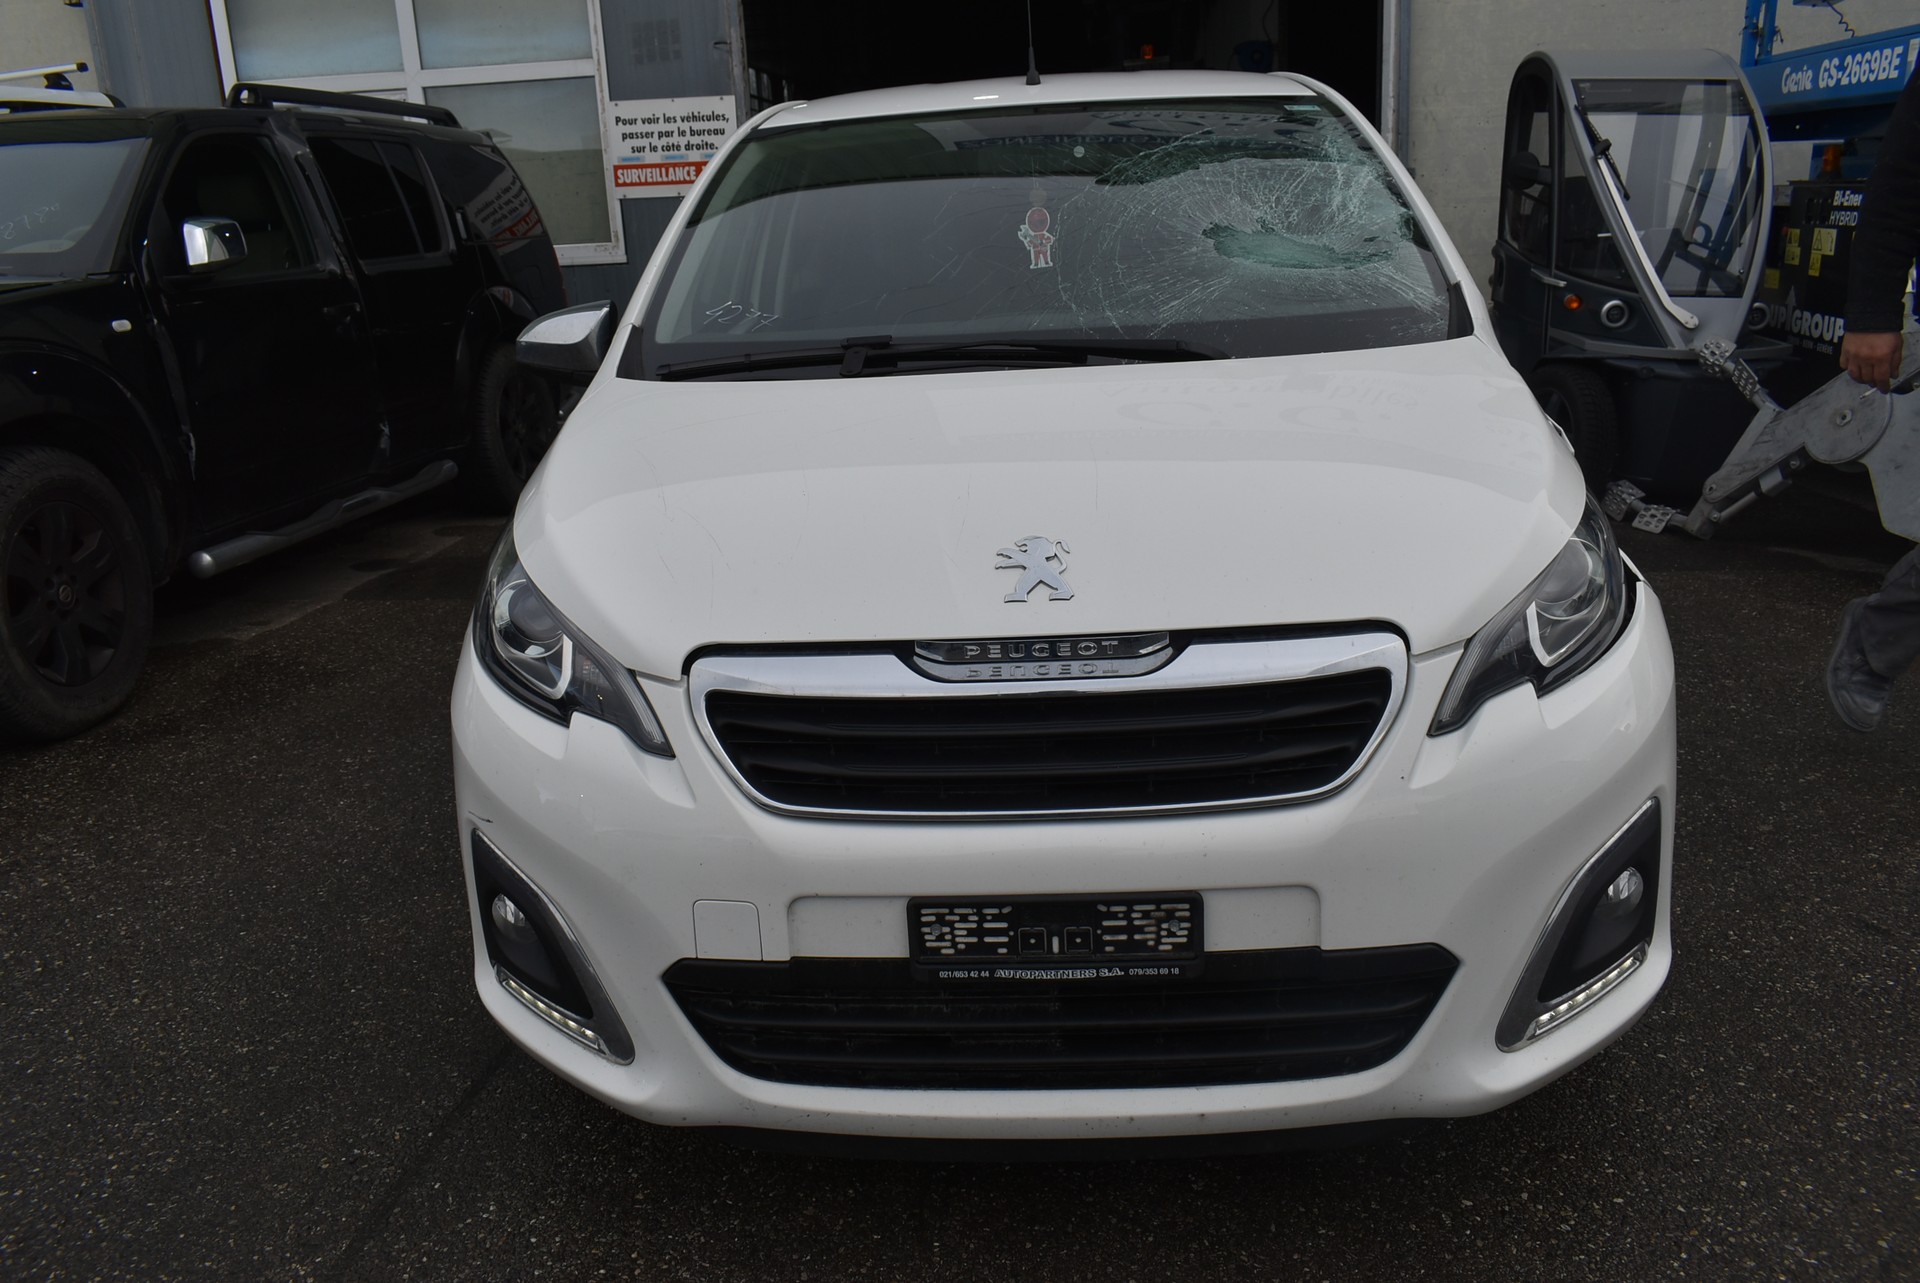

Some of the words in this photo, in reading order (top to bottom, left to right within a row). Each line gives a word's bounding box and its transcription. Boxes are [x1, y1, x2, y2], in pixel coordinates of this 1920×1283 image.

[1781, 64, 1813, 94] Genie
[1818, 45, 1904, 89] GS-2669BE
[615, 116, 638, 126] Pour
[641, 113, 660, 124] voir
[663, 112, 677, 124] les
[680, 110, 729, 123] véhicules,
[622, 130, 654, 142] passer
[658, 129, 674, 141] par
[677, 126, 687, 137] le
[689, 125, 725, 137] bureau
[631, 144, 646, 154] sur
[649, 142, 658, 153] le
[661, 141, 682, 152] côté
[684, 139, 719, 151] droite.
[617, 165, 697, 184] SURVEILLANCE
[1833, 190, 1863, 206] Bi-Ener
[1829, 211, 1859, 227] HYBRID
[1791, 308, 1845, 344] GROUP
[963, 640, 1119, 659] PEUGEOT
[939, 970, 968, 979] 021/653
[970, 970, 979, 978] 42
[980, 970, 989, 978] 44
[994, 968, 1097, 980] AUTOPARTNERS
[1098, 967, 1125, 978] S.A.
[1128, 967, 1158, 976] 079/353
[1170, 967, 1180, 975] 18
